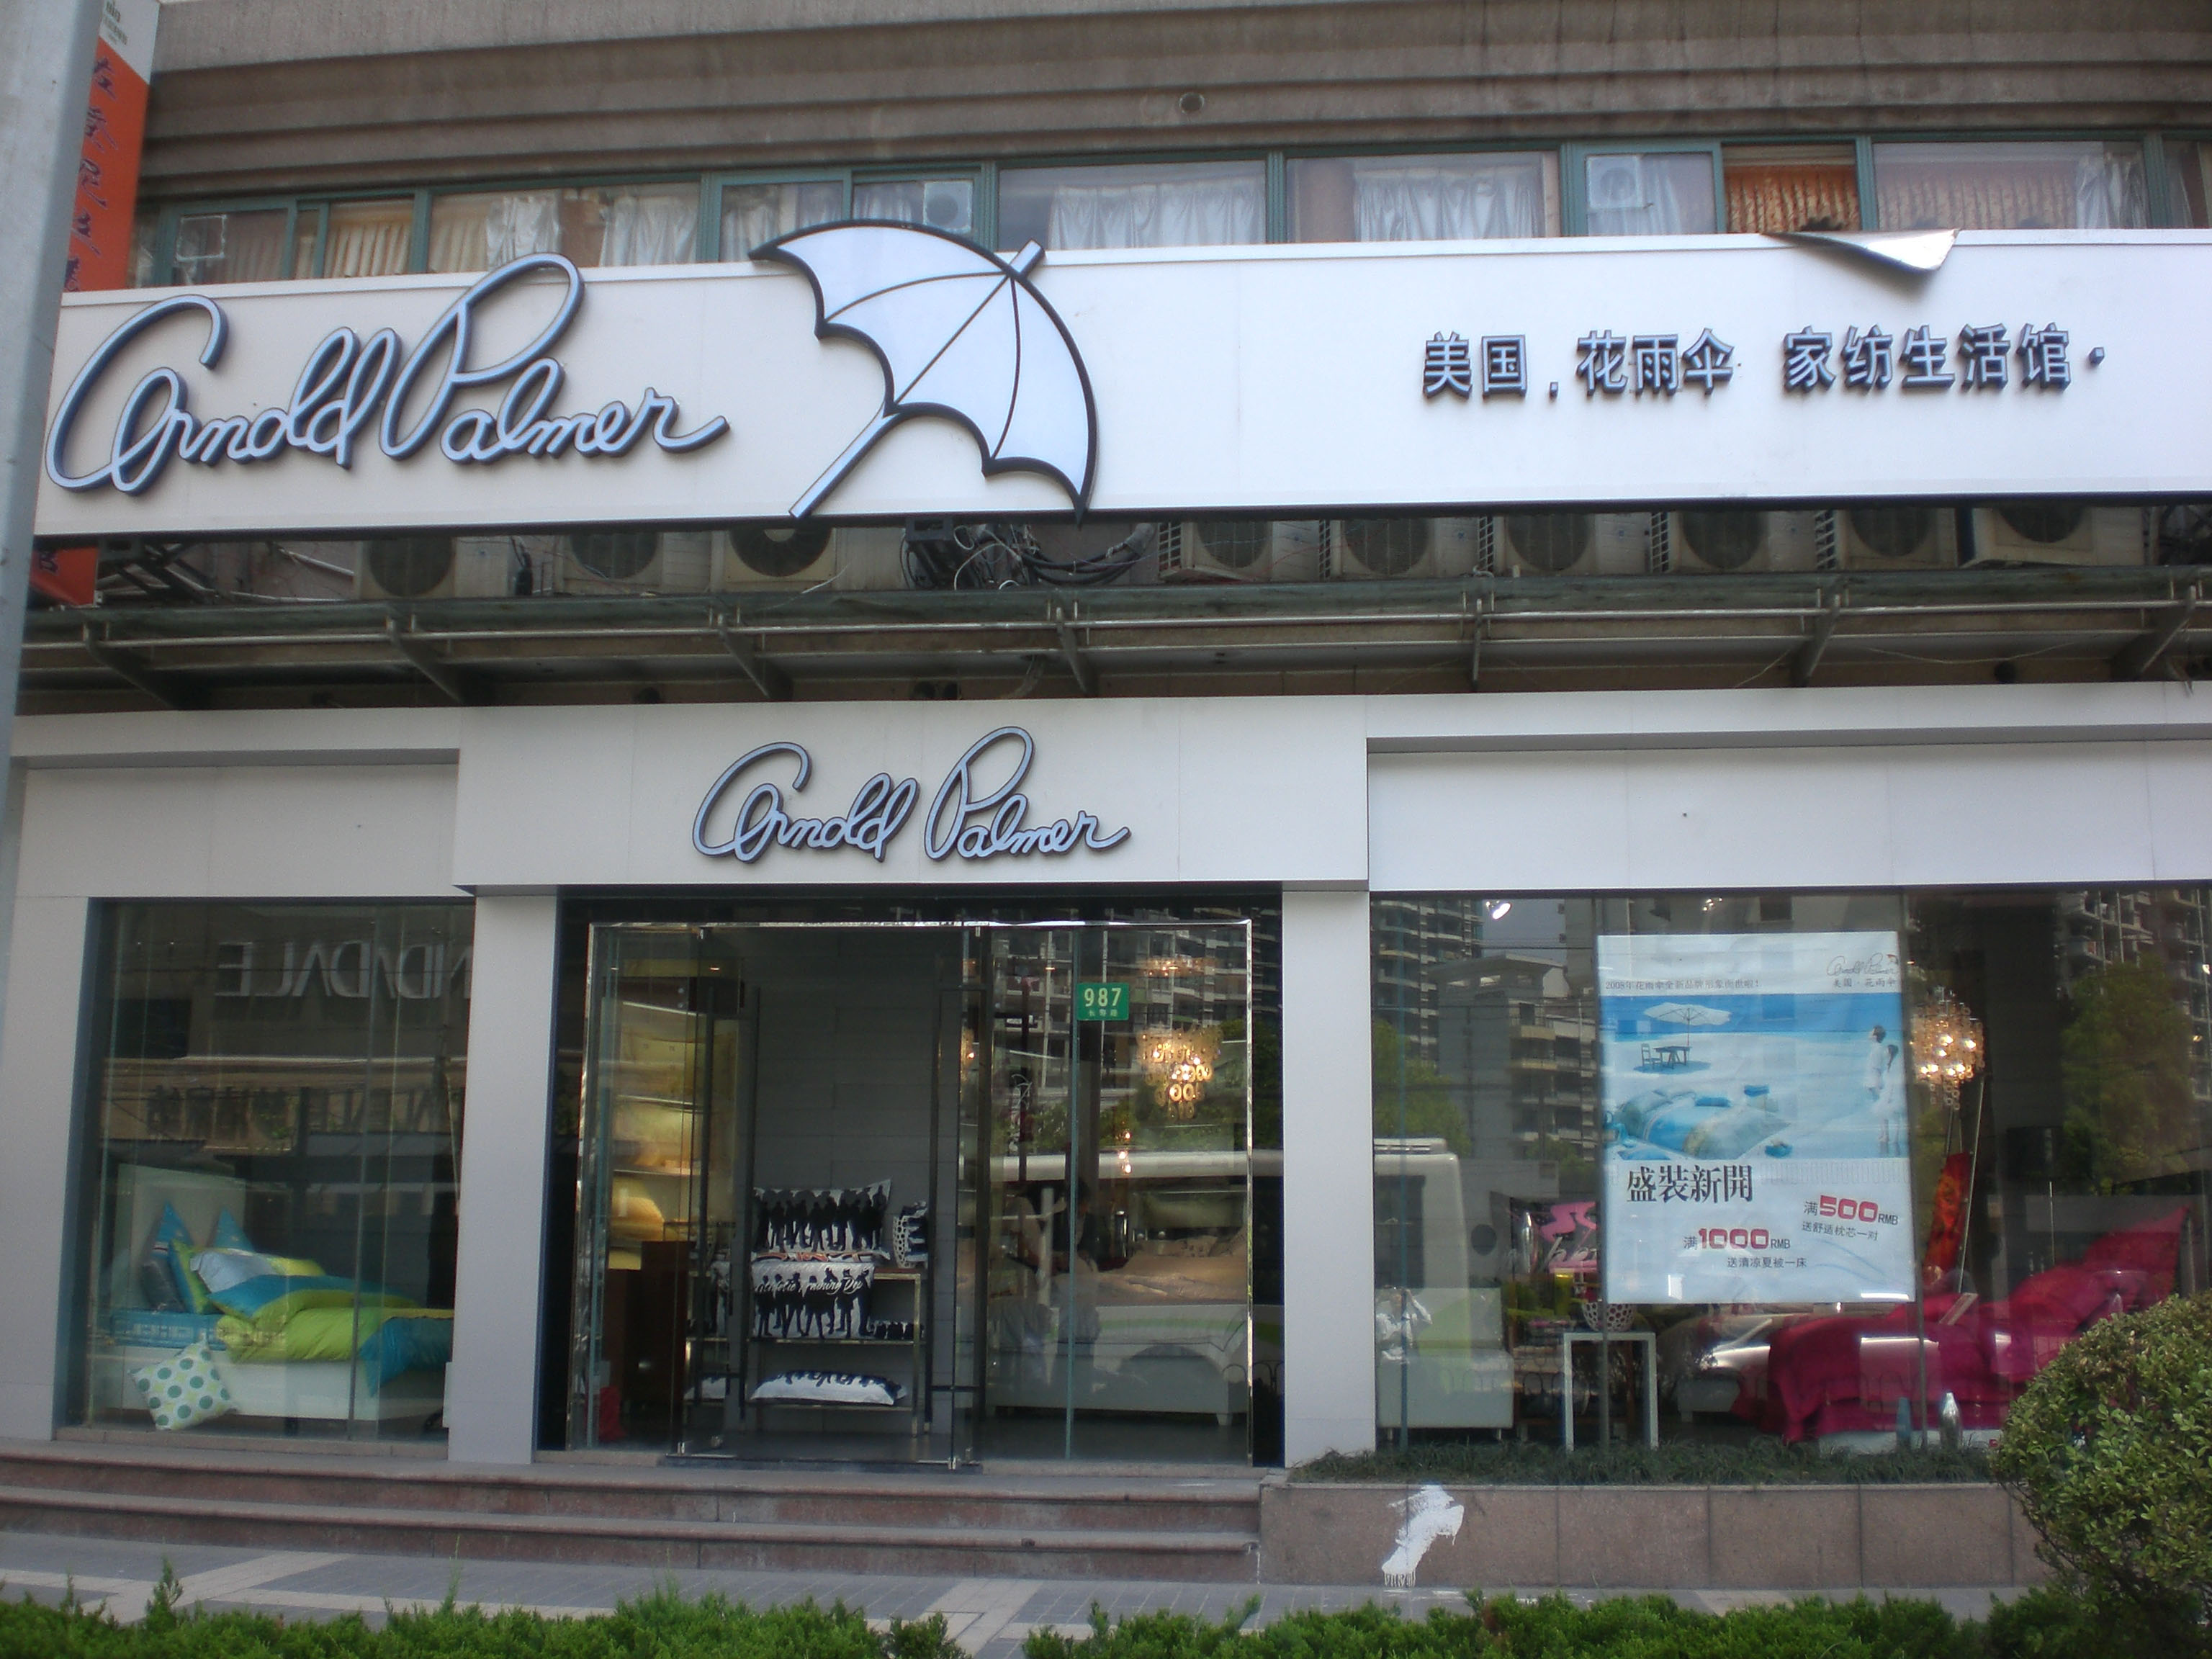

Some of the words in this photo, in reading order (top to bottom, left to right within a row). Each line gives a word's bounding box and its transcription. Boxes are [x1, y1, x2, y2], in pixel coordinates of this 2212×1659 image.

[46, 295, 400, 494] Arnold
[380, 252, 730, 464] Palmer
[693, 742, 920, 864] Arnold
[925, 726, 1131, 864] Palmer
[1084, 988, 1122, 1007] 987
[1627, 1165, 1753, 1203] 盛裝新開
[1727, 1257, 1807, 1269] 送清凉夏被一床
